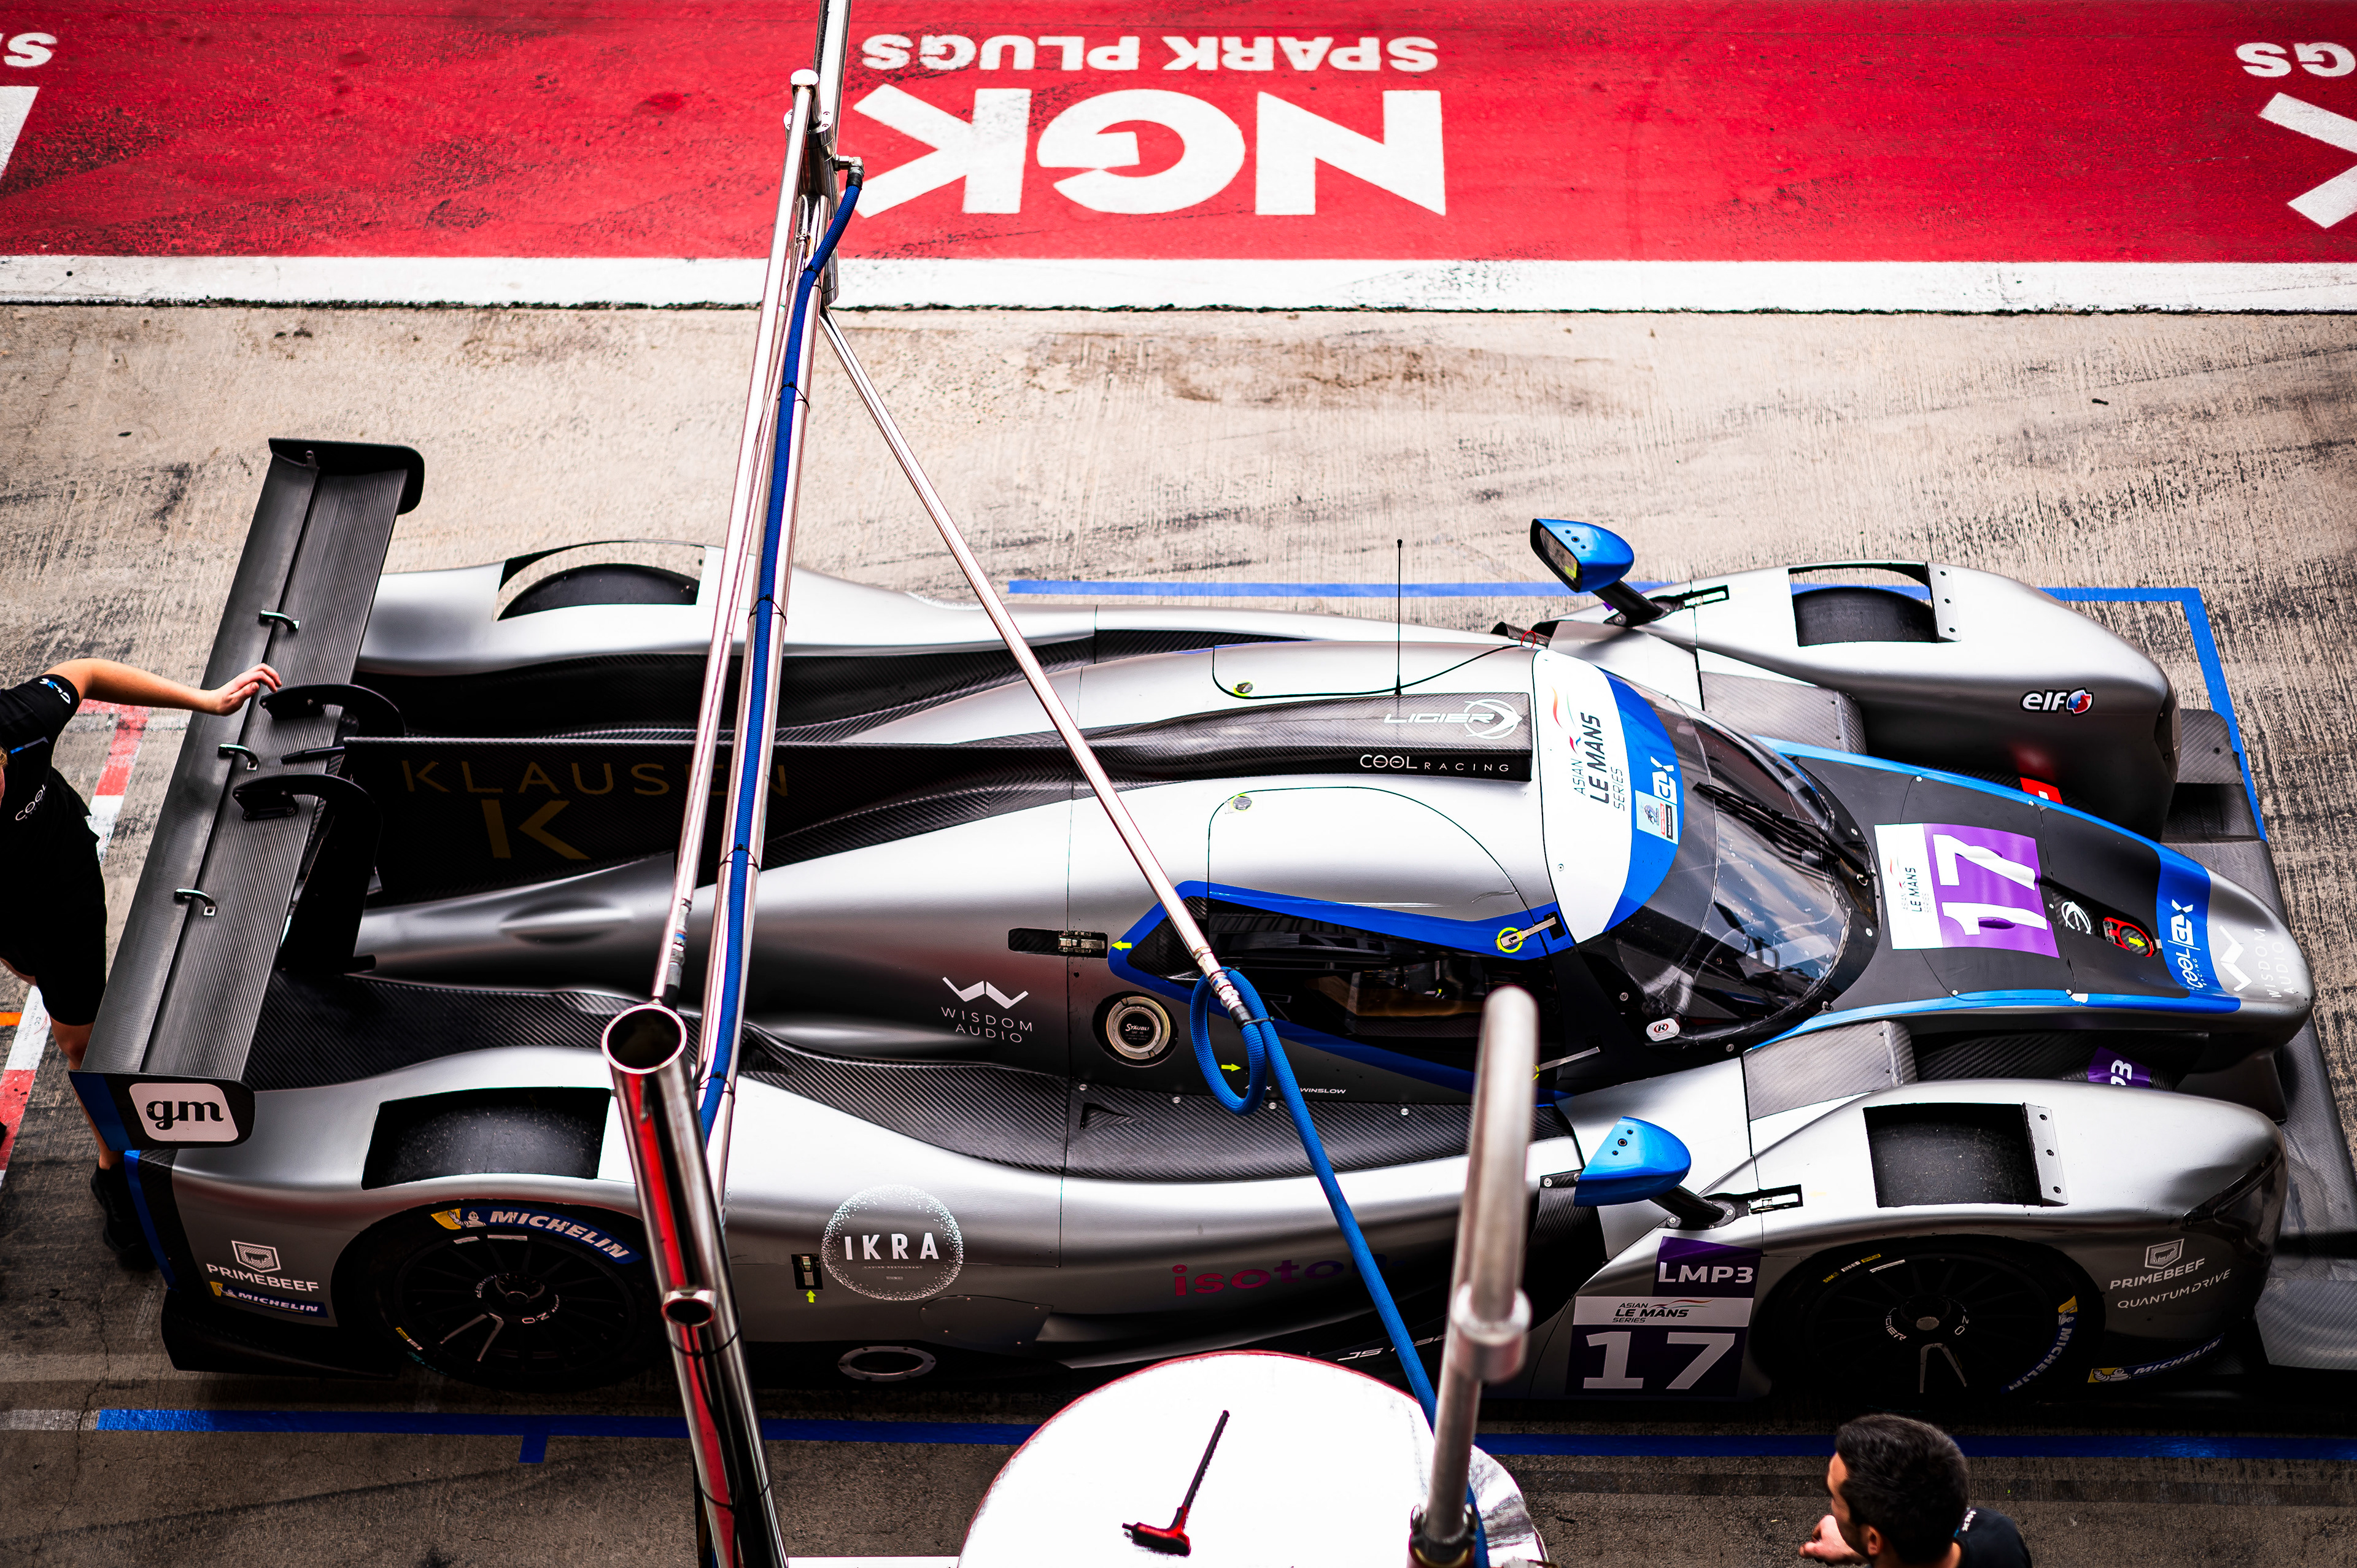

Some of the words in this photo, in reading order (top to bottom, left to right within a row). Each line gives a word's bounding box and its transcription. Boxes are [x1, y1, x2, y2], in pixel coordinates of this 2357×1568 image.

[861, 34, 1140, 71] PLUGS
[1163, 36, 1438, 71] SPARK
[850, 83, 1446, 218] NGK
[2022, 692, 2067, 711] elf
[1384, 713, 1495, 724] LIGIER
[1581, 712, 1607, 773] MANS
[1360, 754, 1418, 769] COOL
[1424, 762, 1509, 771] RACING
[1571, 758, 1585, 796] ASIAN
[1589, 775, 1609, 803] LE
[1611, 767, 1625, 811] SERIES
[1905, 867, 1920, 897] MANS
[1933, 833, 2048, 936] 17
[1910, 900, 1922, 912] LE
[2170, 899, 2194, 946] CLX
[2176, 948, 2204, 989] COOL
[2254, 928, 2282, 998] WISDOM
[2272, 941, 2295, 994] AUDIO
[941, 1006, 1032, 1032] WISDOM
[956, 1024, 1022, 1043] AUDIO
[146, 1101, 224, 1130] gm
[490, 1211, 630, 1258] MICHELIN
[845, 1232, 939, 1260] IKRA
[206, 1264, 319, 1292] PRIMEBEEF
[1658, 1262, 1754, 1283] LMP3
[2110, 1258, 2205, 1289] PRIMEBEEF
[238, 1292, 319, 1312] MICHELIN
[1615, 1308, 1636, 1317] LE
[1640, 1308, 1689, 1318] MANS
[1337, 1348, 1384, 1361] JS
[1583, 1331, 1736, 1389] 17
[2009, 1327, 2072, 1391] MICHELIN
[2134, 1338, 2221, 1375] MICHELIN
